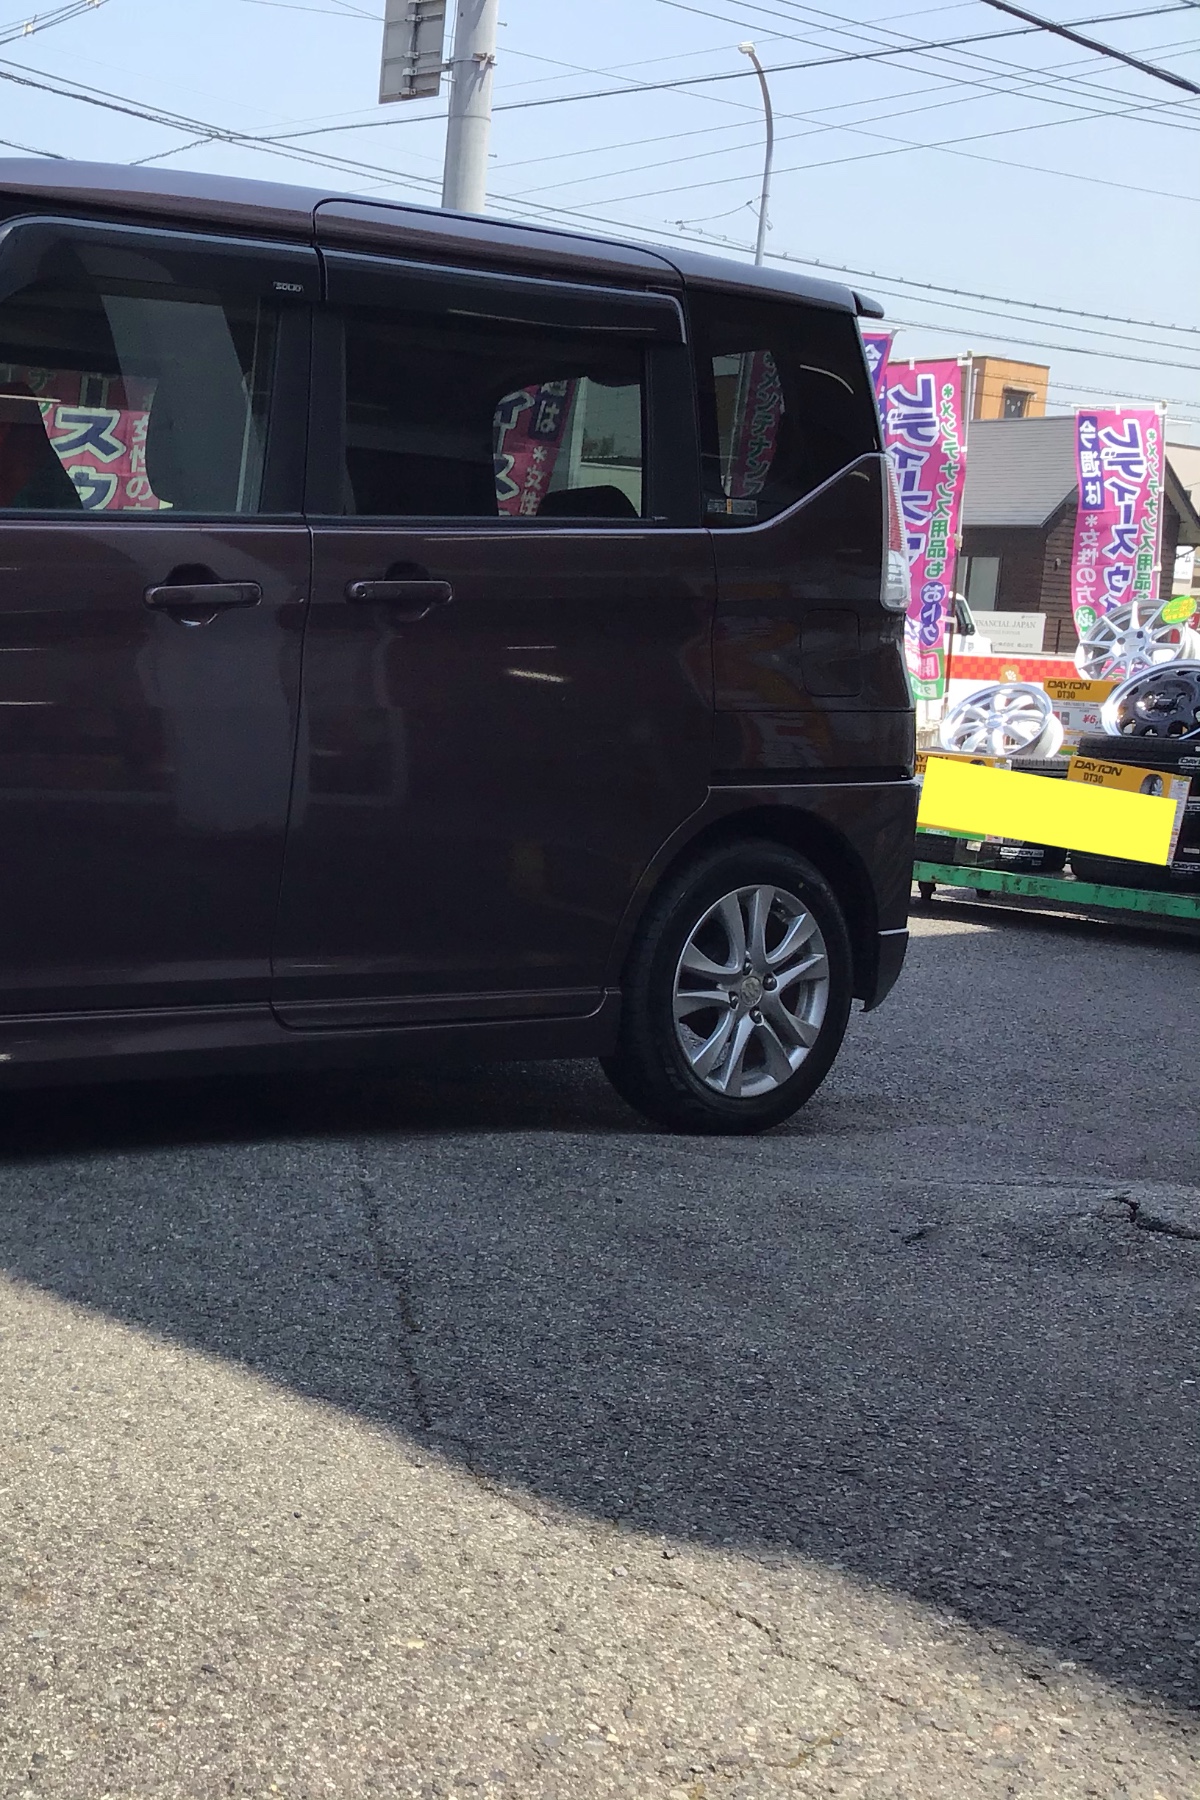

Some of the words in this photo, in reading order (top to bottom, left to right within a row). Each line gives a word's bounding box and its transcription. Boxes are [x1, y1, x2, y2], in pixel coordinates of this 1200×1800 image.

[1047, 680, 1092, 691] DAYTON
[1057, 690, 1076, 699] DT30
[1074, 759, 1123, 777] DAYTON
[1083, 772, 1104, 784] DT30
